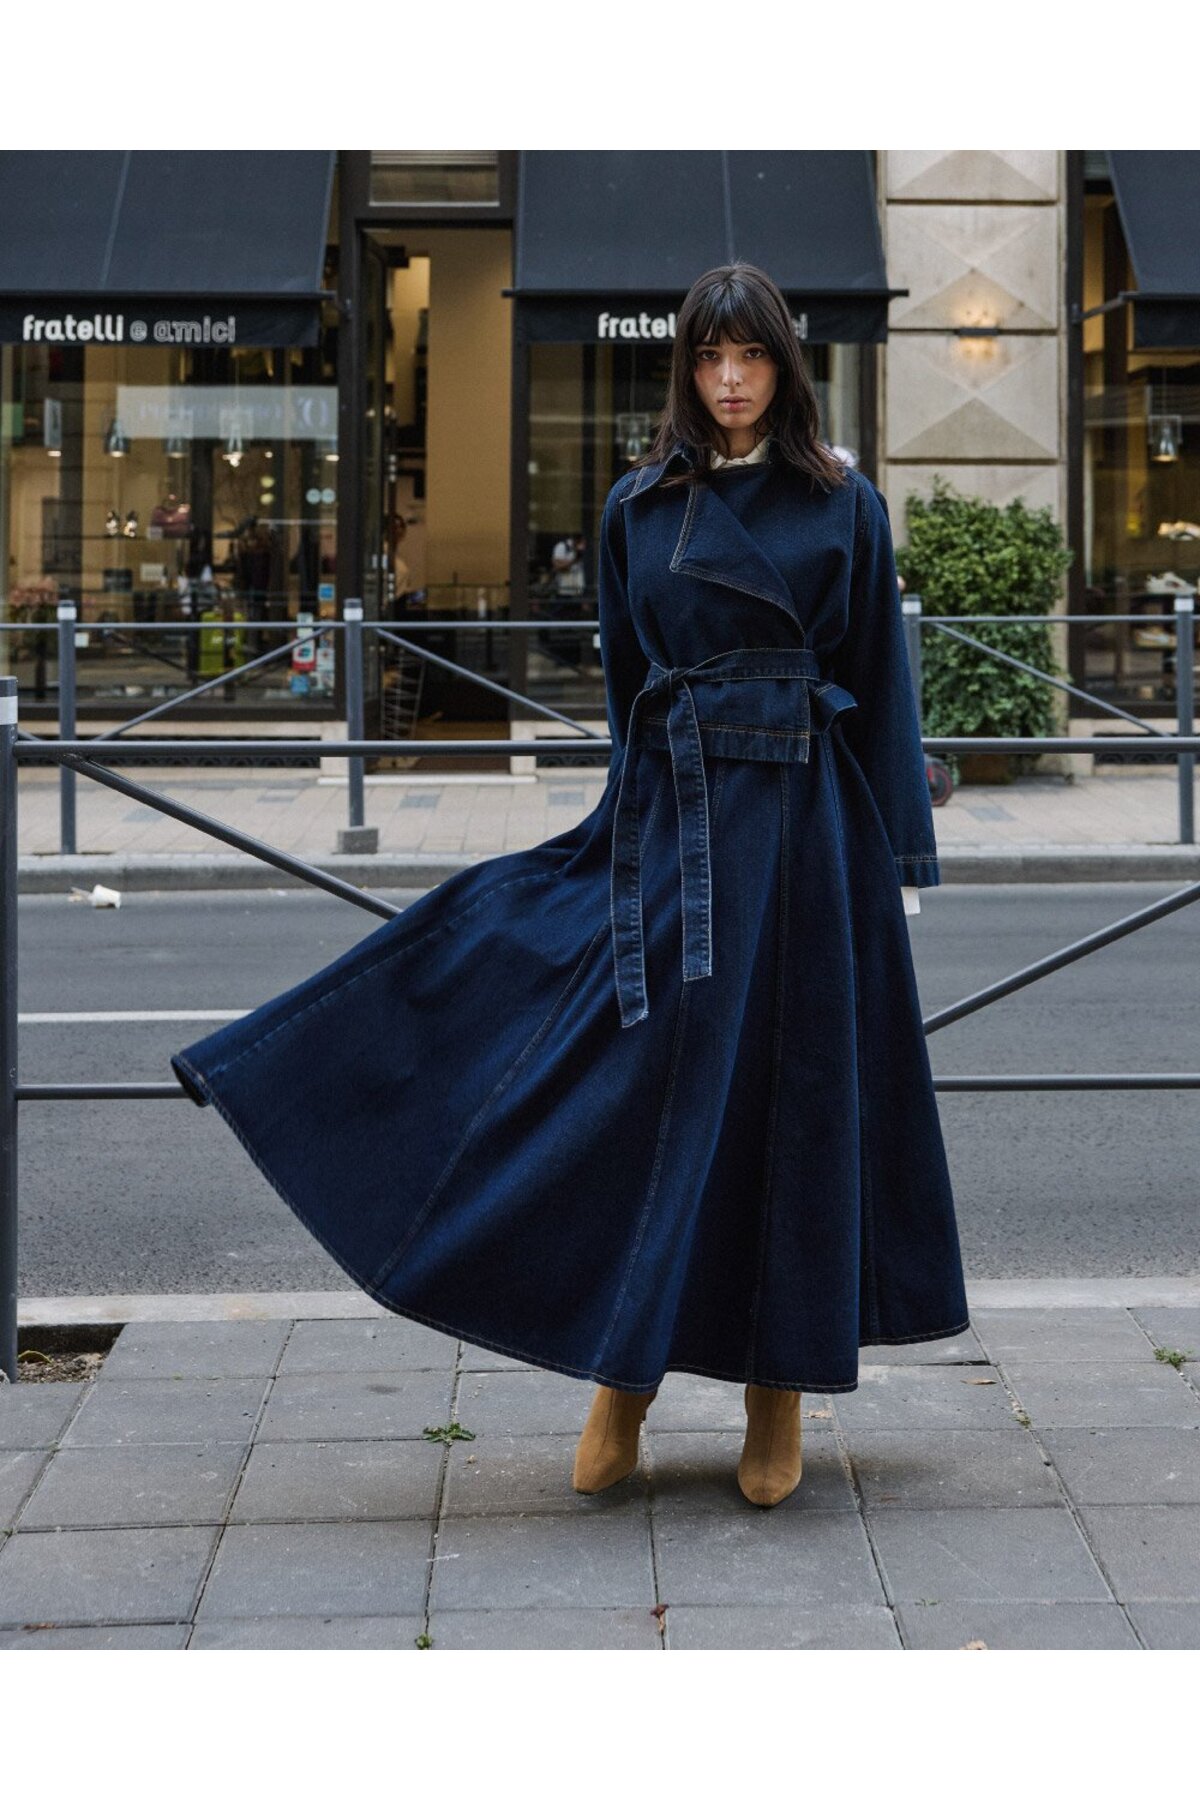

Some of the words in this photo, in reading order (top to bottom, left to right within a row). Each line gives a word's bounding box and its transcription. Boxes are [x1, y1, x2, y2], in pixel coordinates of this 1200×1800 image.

[22, 314, 124, 341] fratelli
[129, 320, 148, 342] e
[153, 316, 236, 343] amici
[598, 312, 677, 339] fratel
